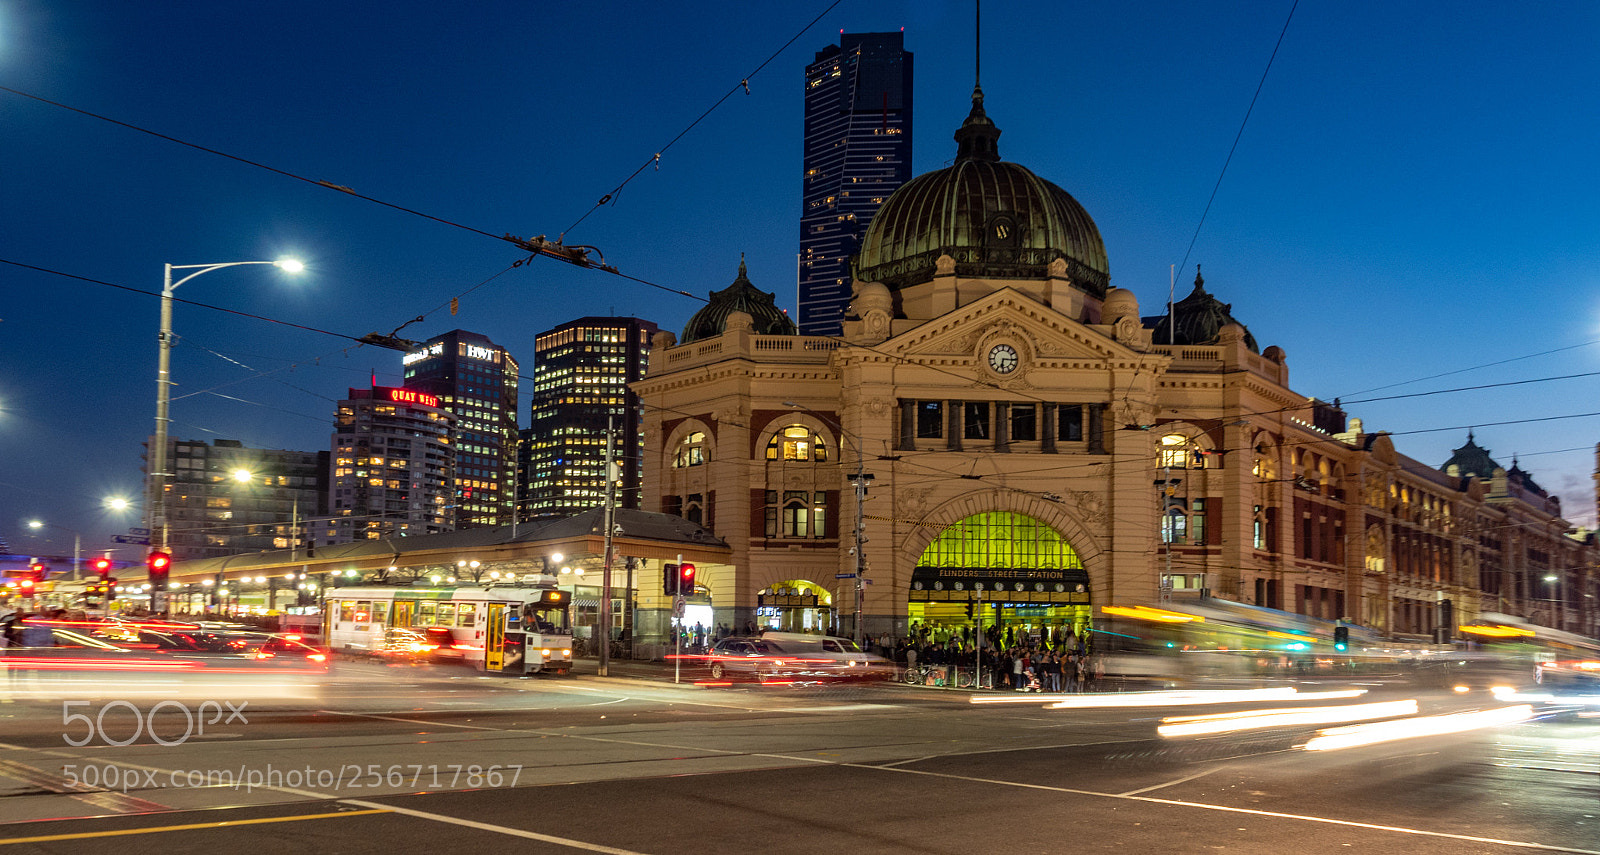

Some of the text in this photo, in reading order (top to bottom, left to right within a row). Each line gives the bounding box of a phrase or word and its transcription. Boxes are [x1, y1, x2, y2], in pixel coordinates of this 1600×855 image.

[392, 389, 437, 408] QUAY WEST
[939, 569, 1063, 579] FLINDERS STREET STATION
